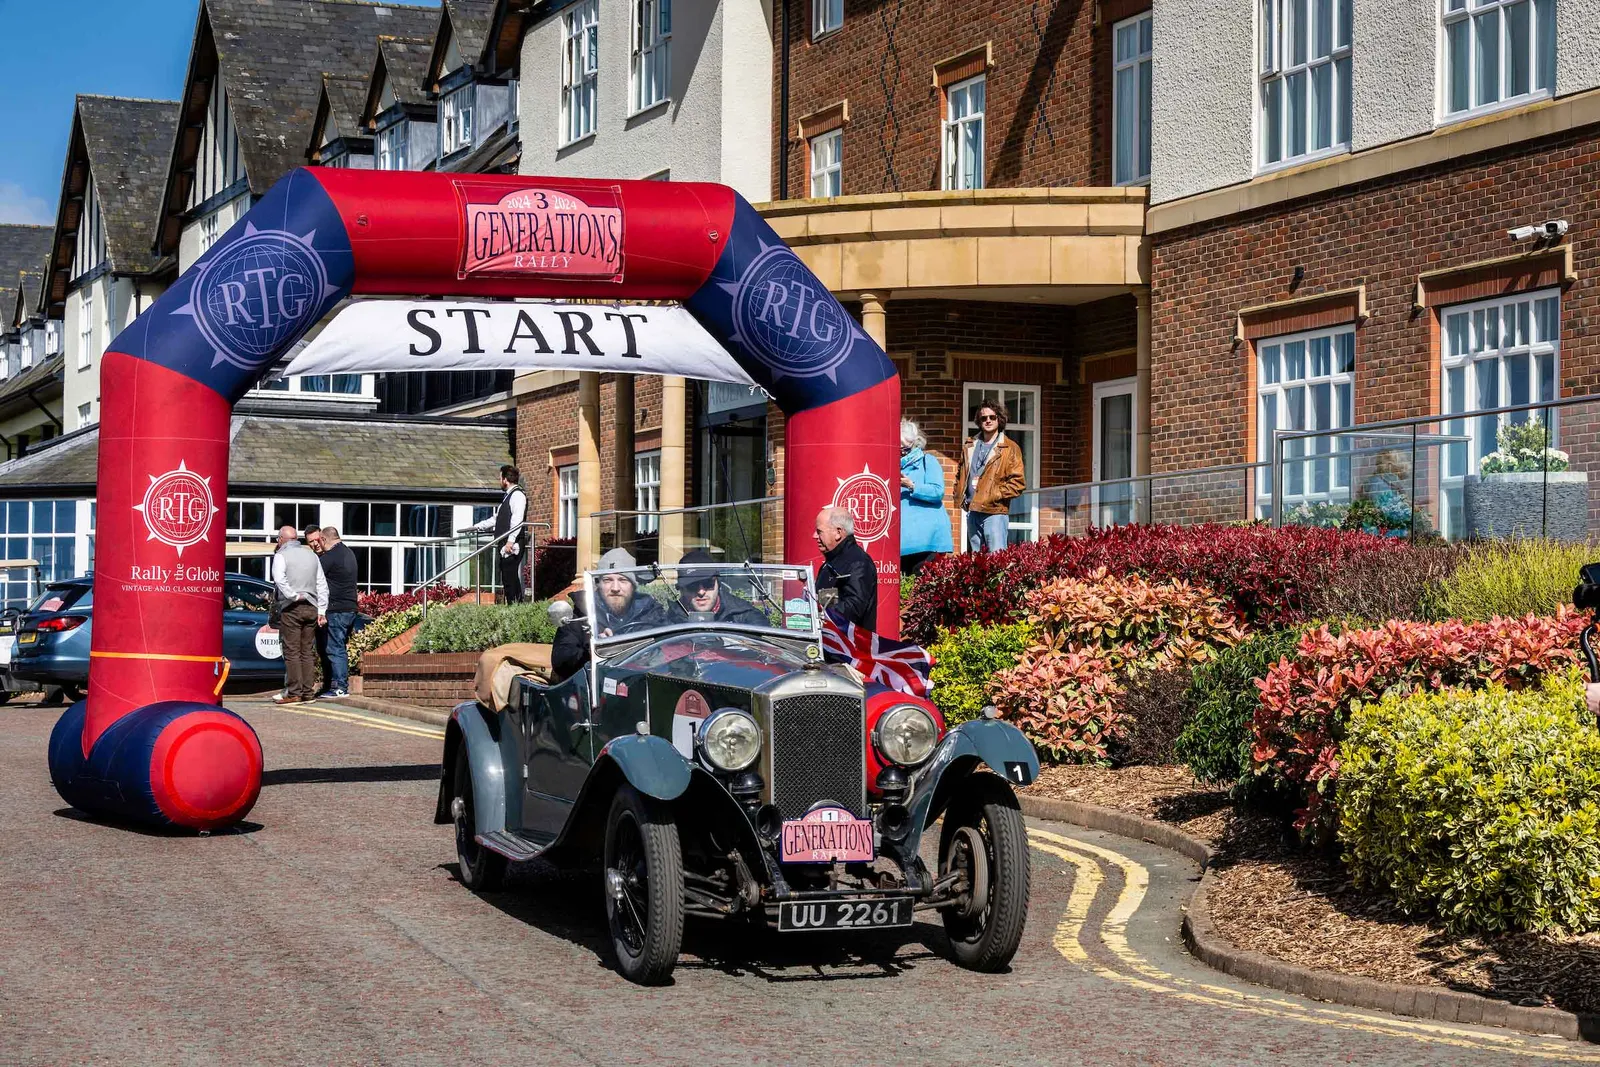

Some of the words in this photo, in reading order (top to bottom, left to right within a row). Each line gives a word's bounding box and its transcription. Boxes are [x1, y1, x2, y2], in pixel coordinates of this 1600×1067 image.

[506, 195, 531, 209] 2024
[533, 191, 549, 210] 3
[551, 195, 577, 210] 2024
[474, 211, 618, 263] GENERATIONS
[513, 255, 573, 269] RALLY
[217, 267, 307, 329] RTG
[755, 279, 837, 342] RTG
[406, 308, 648, 359] START
[159, 492, 204, 524] RTG
[846, 493, 885, 522] RTG
[131, 565, 171, 583] Rally
[174, 563, 185, 581] the
[186, 566, 220, 581] Globe
[873, 560, 898, 574] Globe
[121, 584, 152, 592] VINTAGE
[173, 585, 200, 593] CLASSIC
[260, 638, 279, 646] MEDI
[1013, 765, 1023, 782] 1
[827, 812, 832, 821] 1
[784, 824, 872, 856] GENERATIONS
[812, 850, 848, 860] RALLY
[792, 905, 827, 927] UU
[837, 902, 899, 926] 2261
